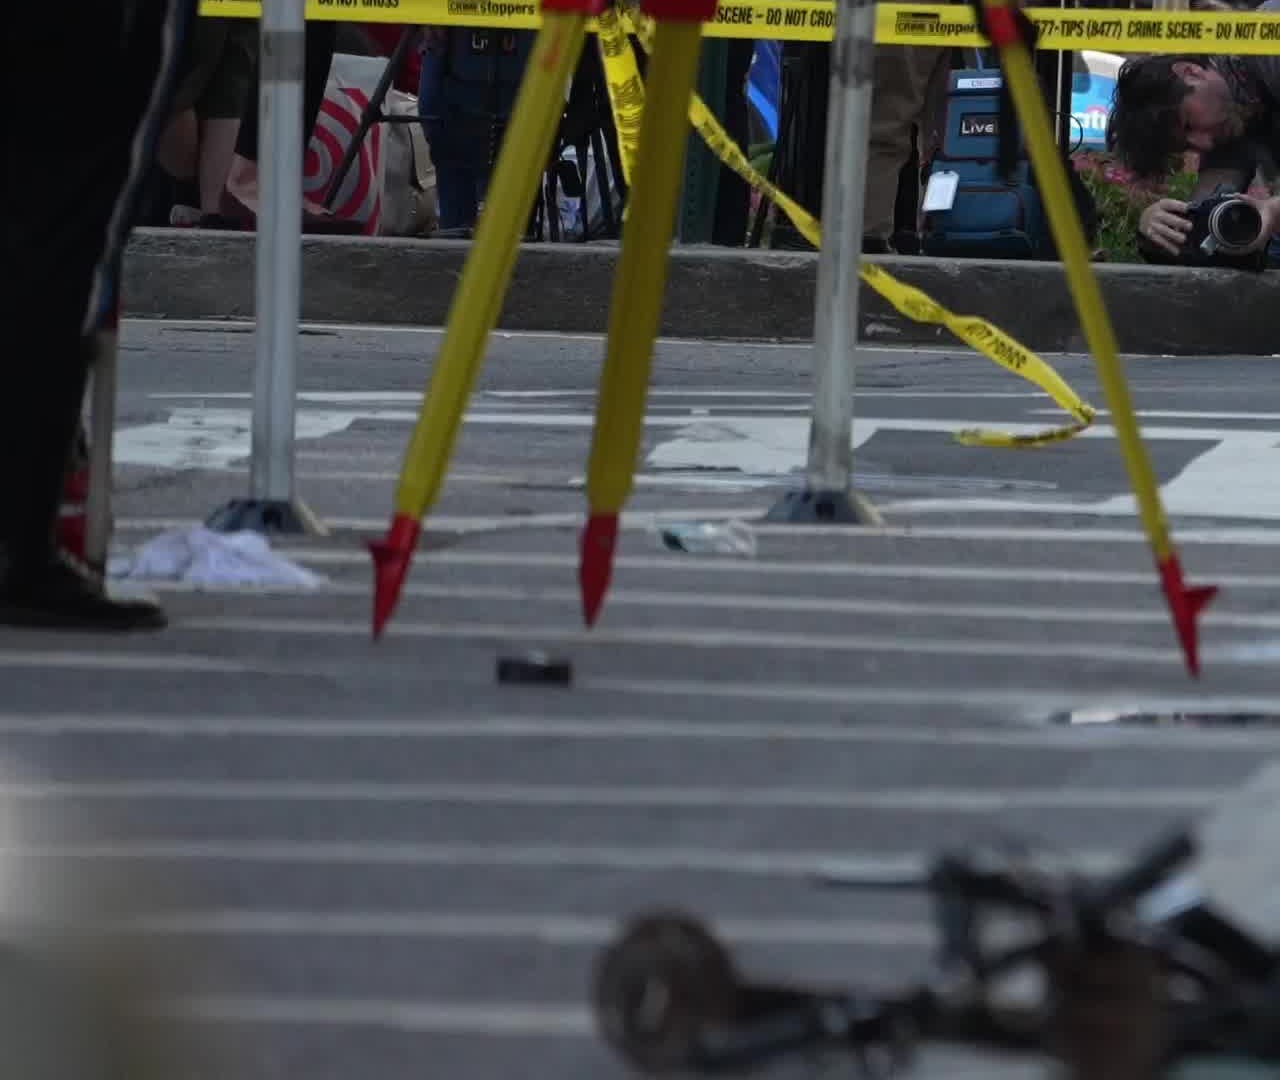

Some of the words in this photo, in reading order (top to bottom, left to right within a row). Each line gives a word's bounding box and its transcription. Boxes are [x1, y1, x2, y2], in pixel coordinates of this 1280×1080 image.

[480, 0, 535, 16] stoppers
[717, 6, 753, 25] SCENE
[766, 8, 782, 26] DO
[784, 8, 806, 27] NOT
[810, 9, 834, 28] CRO
[928, 20, 977, 35] stopper
[1086, 20, 1122, 40] (8477)
[1127, 21, 1163, 39] CRIME
[1166, 22, 1203, 39] SCENE
[1216, 22, 1232, 40] DO
[1234, 22, 1257, 40] NOT
